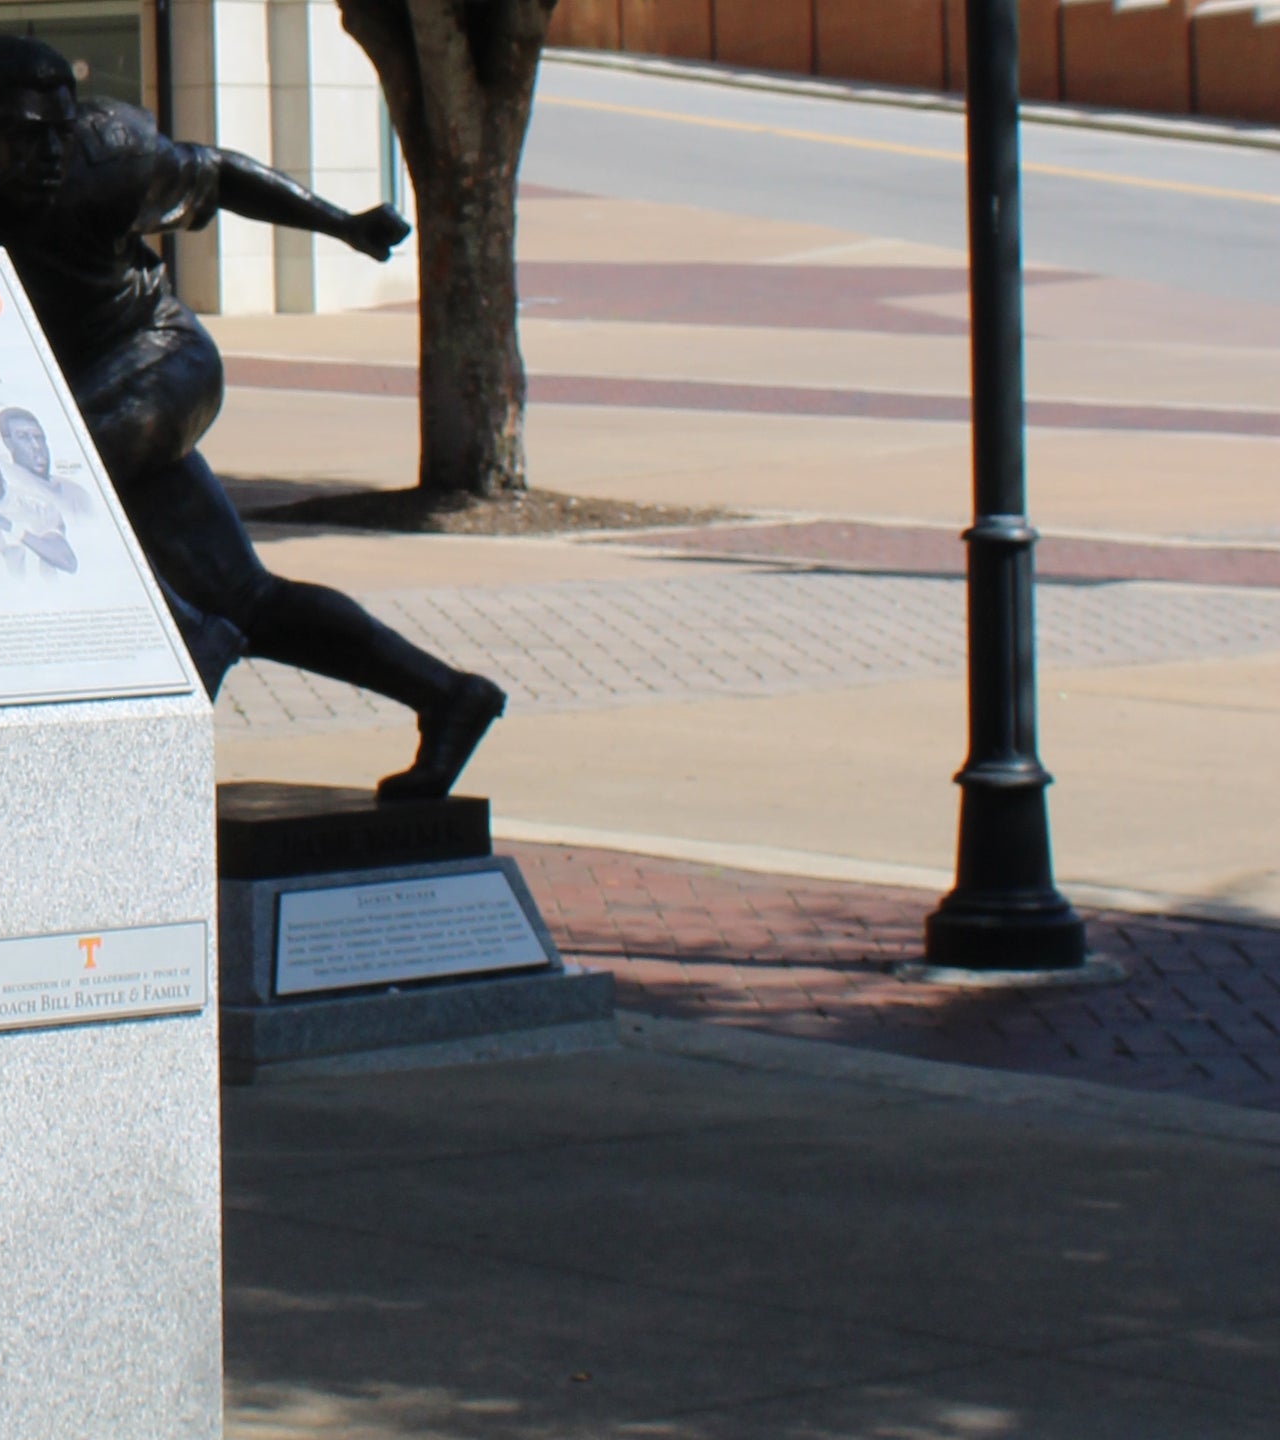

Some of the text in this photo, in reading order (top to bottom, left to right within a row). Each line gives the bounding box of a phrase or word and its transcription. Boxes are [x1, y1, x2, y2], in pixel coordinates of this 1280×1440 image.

[78, 936, 102, 969] T
[2, 981, 59, 994] RECOGNITION
[41, 993, 70, 1012] BILL
[74, 990, 126, 1009] BATTLE
[143, 983, 191, 1001] FAMILY
